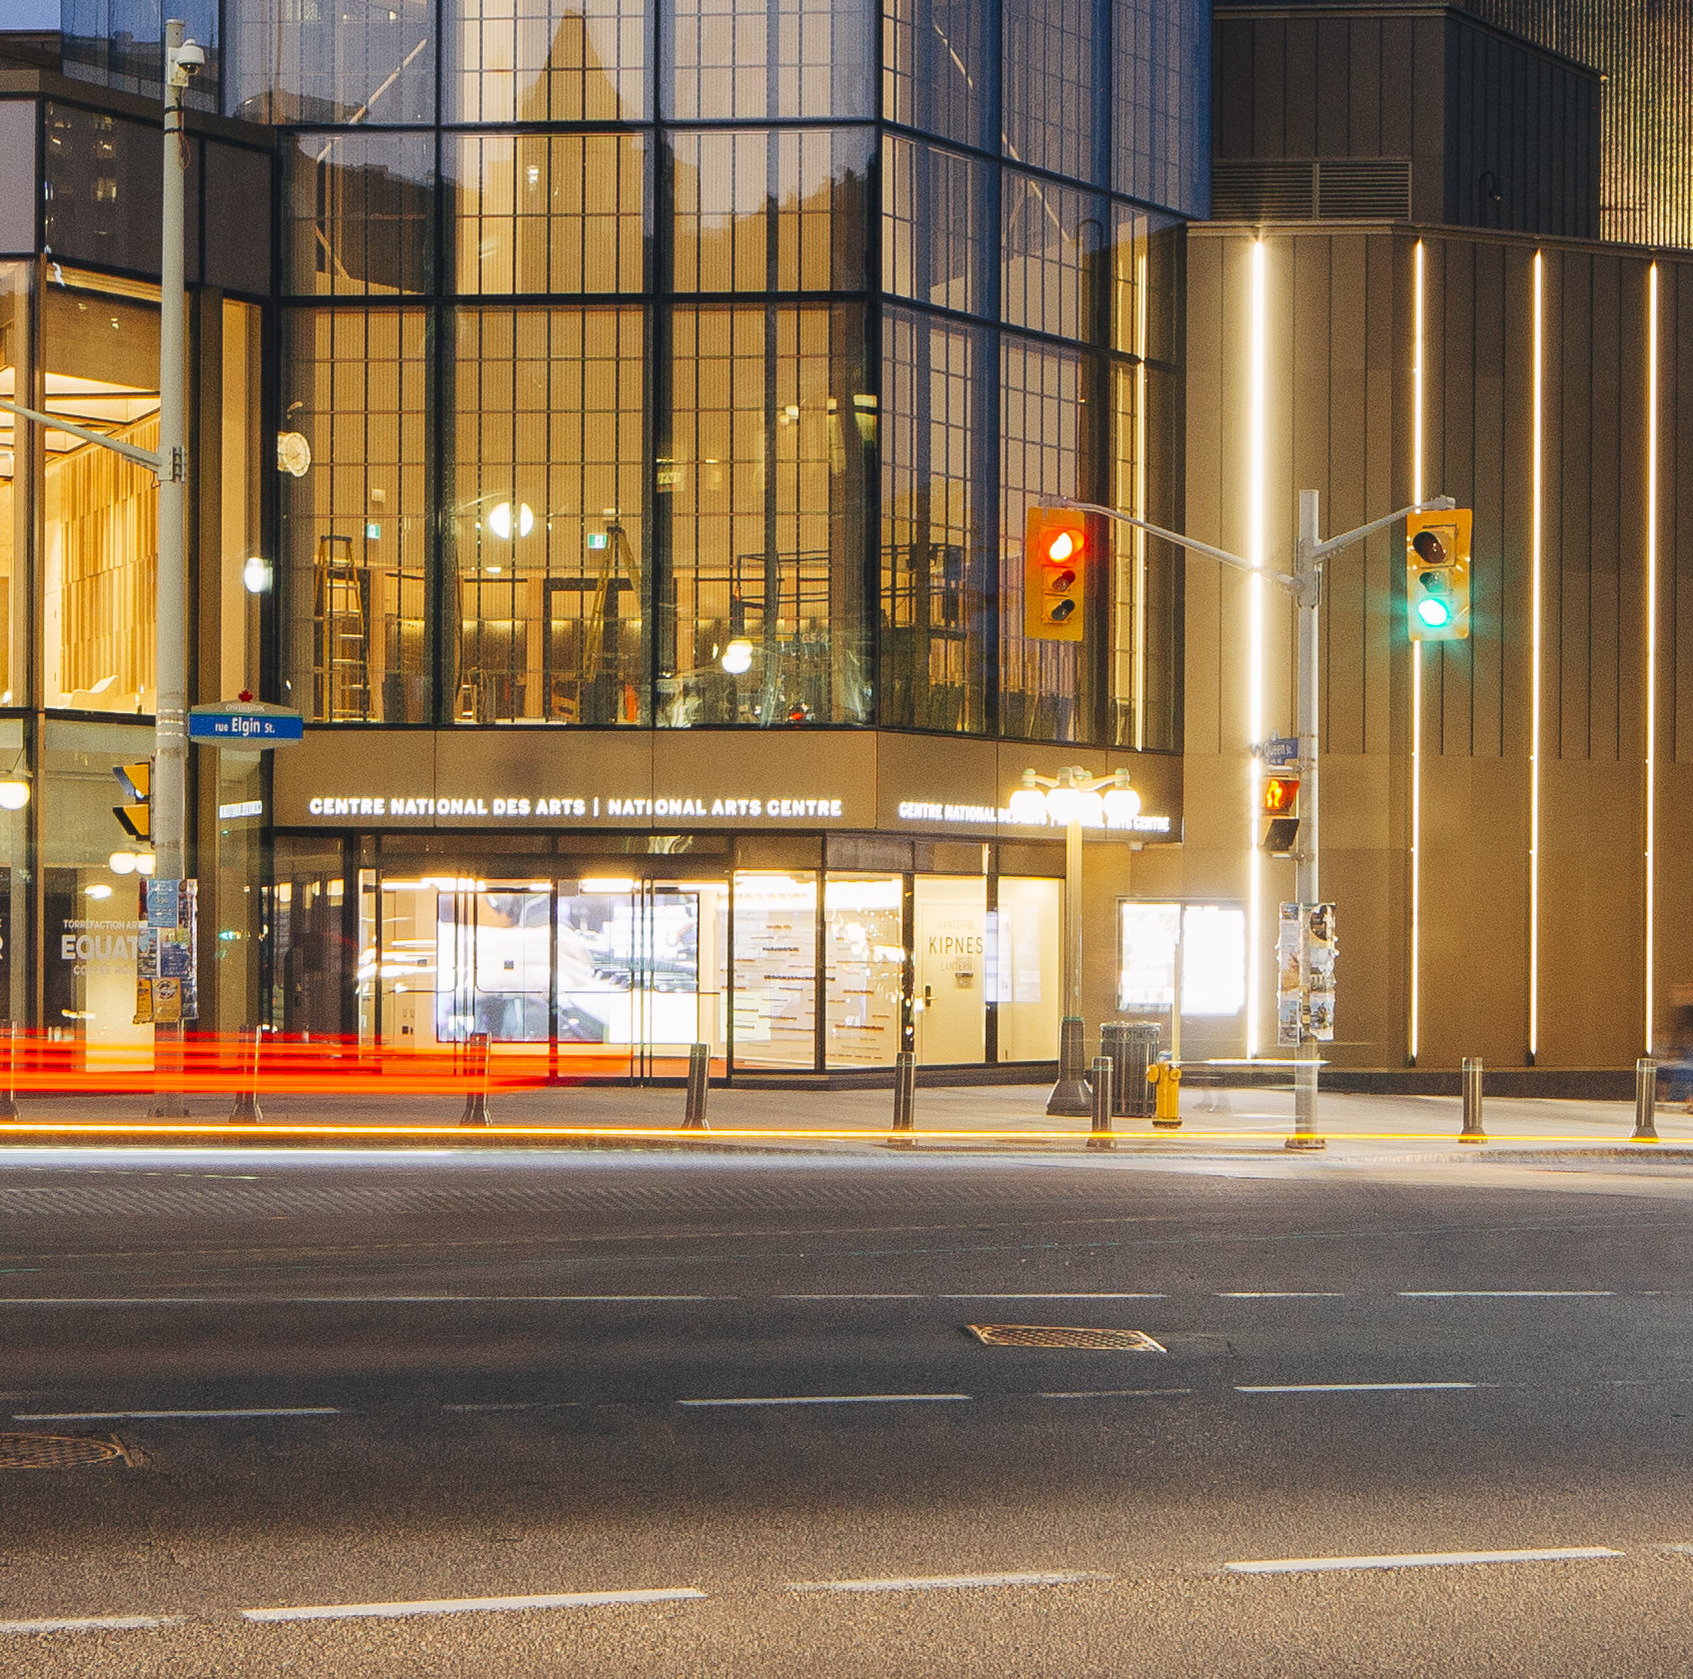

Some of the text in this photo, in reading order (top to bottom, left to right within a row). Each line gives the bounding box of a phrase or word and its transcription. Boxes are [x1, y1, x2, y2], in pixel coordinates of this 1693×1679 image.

[215, 723, 228, 732] rue
[232, 717, 260, 736] Elgin
[309, 798, 385, 816] CENTRE
[390, 798, 488, 816] NATIONAL
[493, 798, 531, 816] DES
[535, 798, 586, 816] ARTS
[608, 798, 706, 817] NATIONAL
[711, 799, 762, 817] ARTS
[767, 799, 842, 817] CENTRE
[898, 801, 943, 820] CENTRE
[944, 804, 996, 823] NATIONAL
[929, 936, 983, 954] KIPNES
